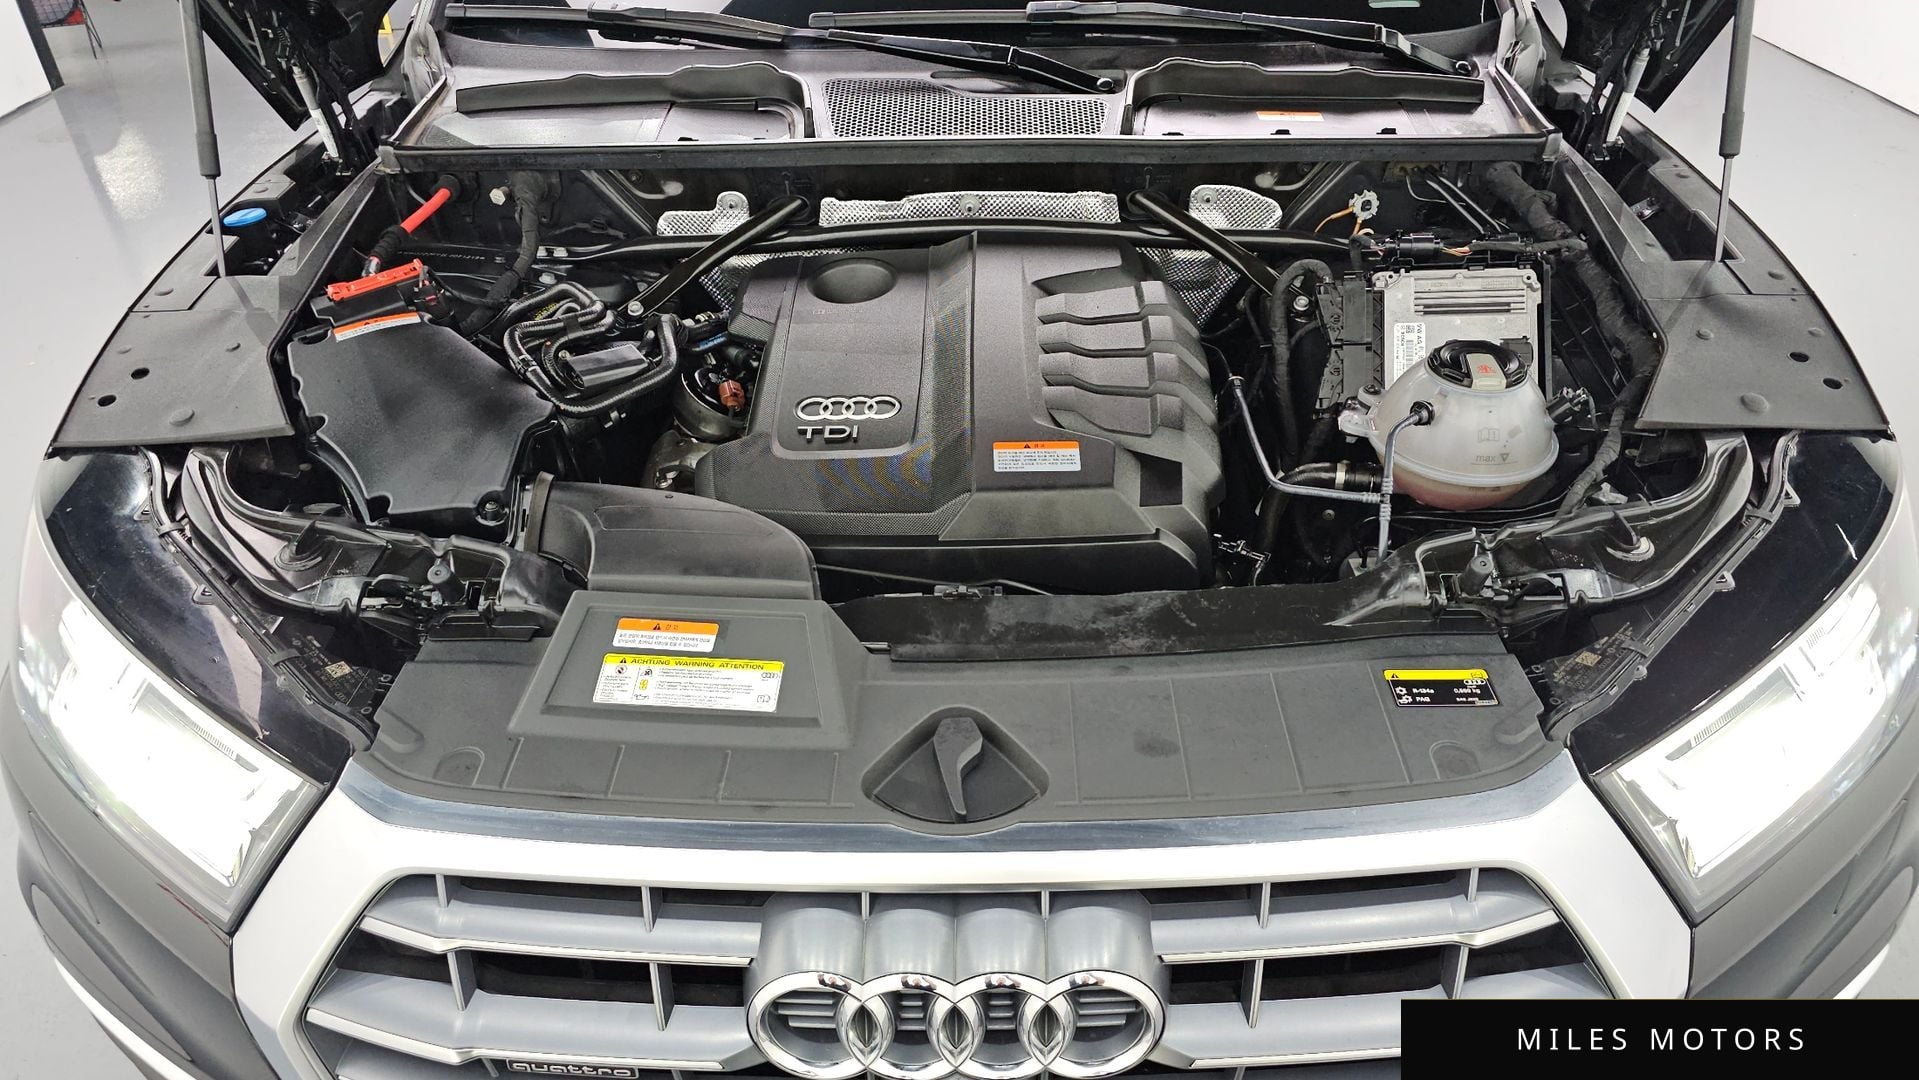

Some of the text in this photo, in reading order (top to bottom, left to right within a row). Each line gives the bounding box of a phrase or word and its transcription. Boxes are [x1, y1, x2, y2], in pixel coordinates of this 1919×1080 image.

[797, 424, 859, 440] TDI
[1475, 455, 1496, 463] max
[631, 658, 765, 671] ACHTUNG WARNING ATTENTION
[512, 1062, 632, 1077] quattro
